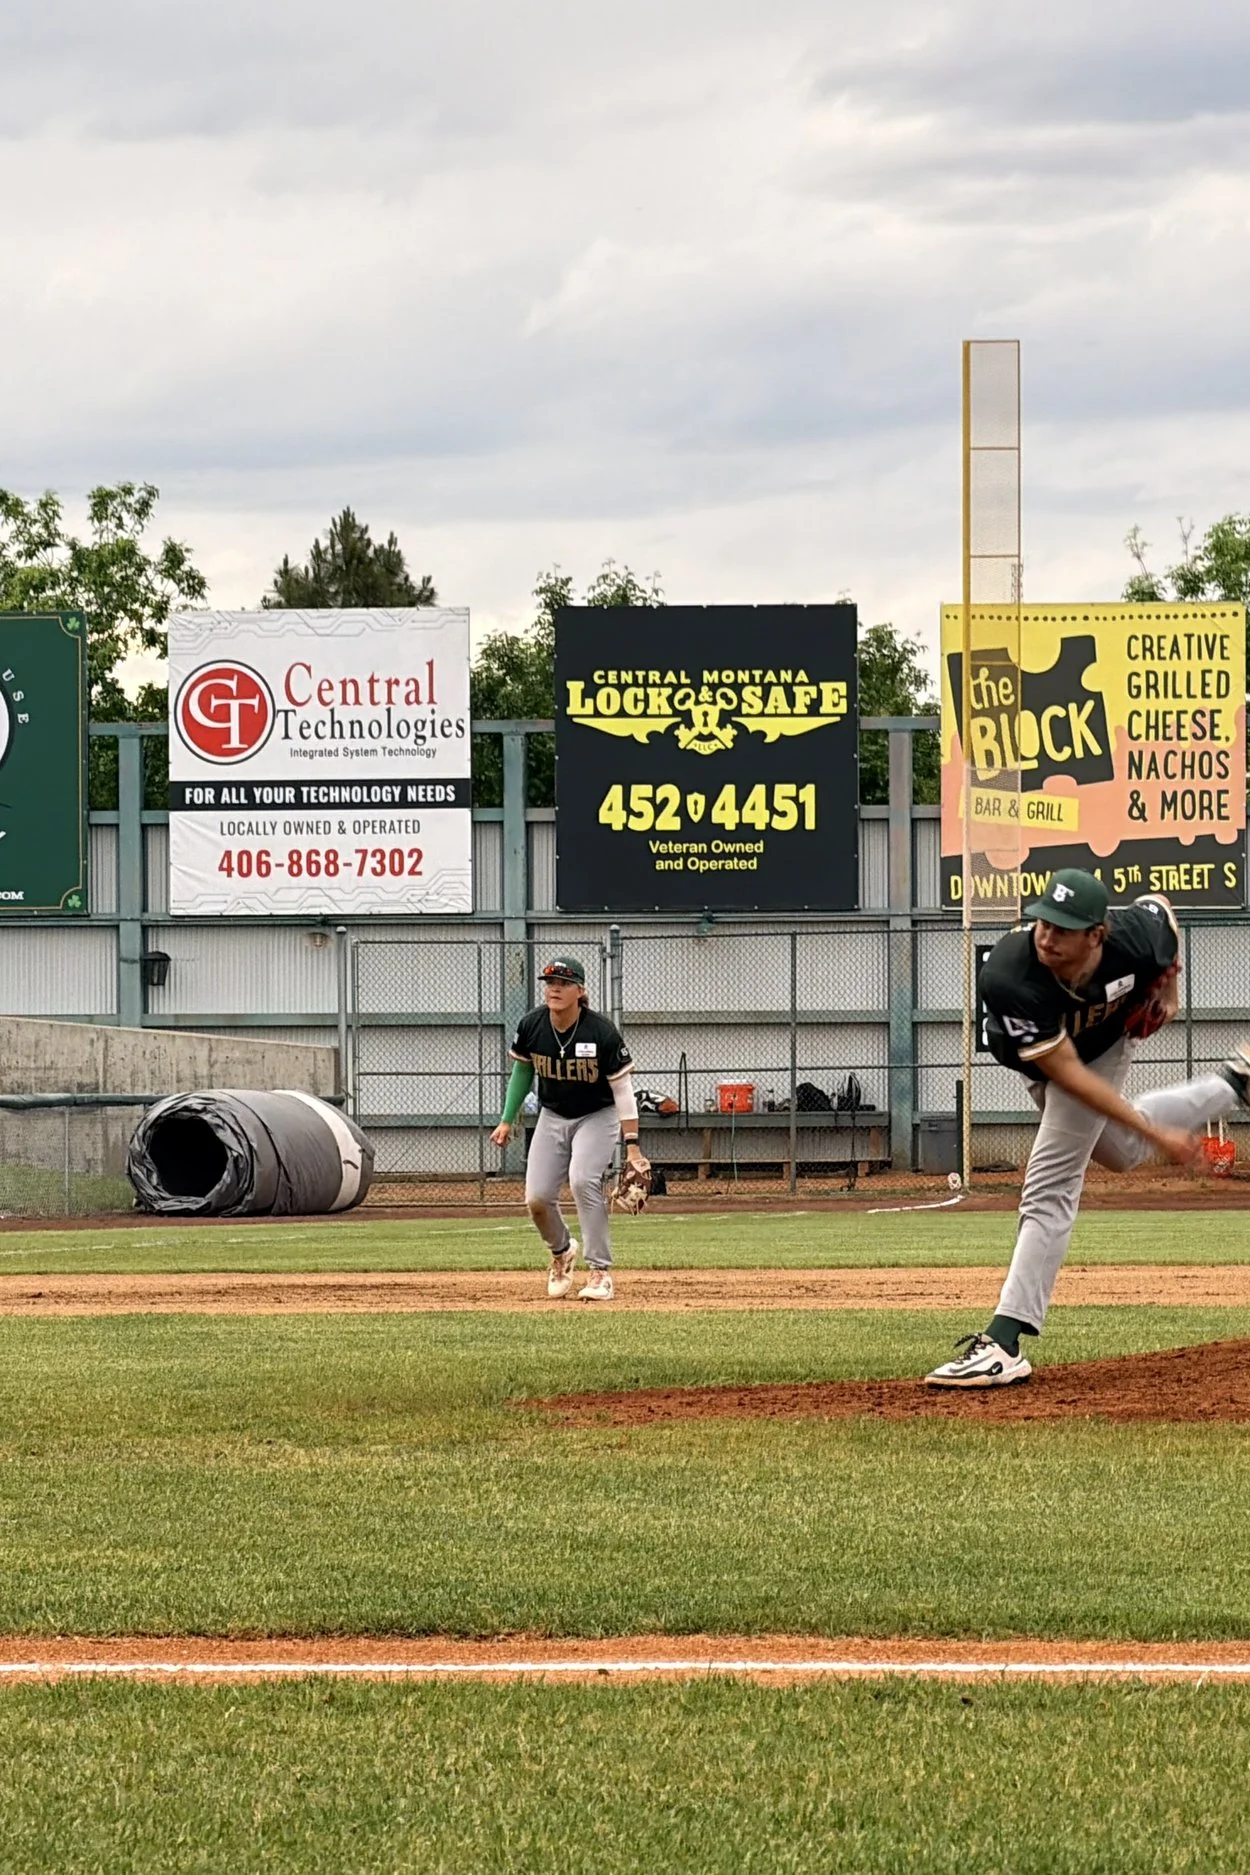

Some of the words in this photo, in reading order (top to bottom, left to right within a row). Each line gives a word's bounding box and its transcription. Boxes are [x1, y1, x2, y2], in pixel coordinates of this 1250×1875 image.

[1126, 633, 1231, 661] CREATIVE
[285, 659, 436, 707] Central
[593, 670, 691, 684] CENTRAL
[703, 669, 809, 684] MONTANA
[970, 666, 1015, 710] the
[1127, 669, 1230, 699] GRILLED
[566, 680, 673, 716] LOCK
[741, 681, 847, 715] SAFE
[276, 709, 465, 745] Technologies
[969, 699, 1103, 782] BLOCK
[290, 747, 339, 759] Integrated
[342, 747, 378, 759] System
[381, 746, 436, 759] Technology
[1127, 750, 1231, 780] NACHOS
[185, 788, 216, 805] FOR
[221, 787, 248, 805] ALL
[253, 786, 295, 804] YOUR
[300, 785, 401, 804] TECHNOLOGY
[407, 785, 456, 802] NEEDS
[599, 784, 681, 831] 452
[711, 784, 816, 831] 4451
[974, 796, 1002, 816] BAR
[1027, 801, 1064, 822] GRILL
[1128, 790, 1148, 822] &
[1160, 789, 1231, 821] MORE
[220, 821, 277, 836] LOCALLY
[283, 820, 331, 836] OWNED
[352, 819, 421, 835] OPERATED
[649, 840, 707, 854] Veteran
[711, 839, 764, 854] Owned
[218, 848, 423, 878] 406-868-7302
[655, 857, 683, 870] and
[687, 857, 757, 873] Operated
[1150, 863, 1215, 891] STREET
[1224, 862, 1237, 888] S
